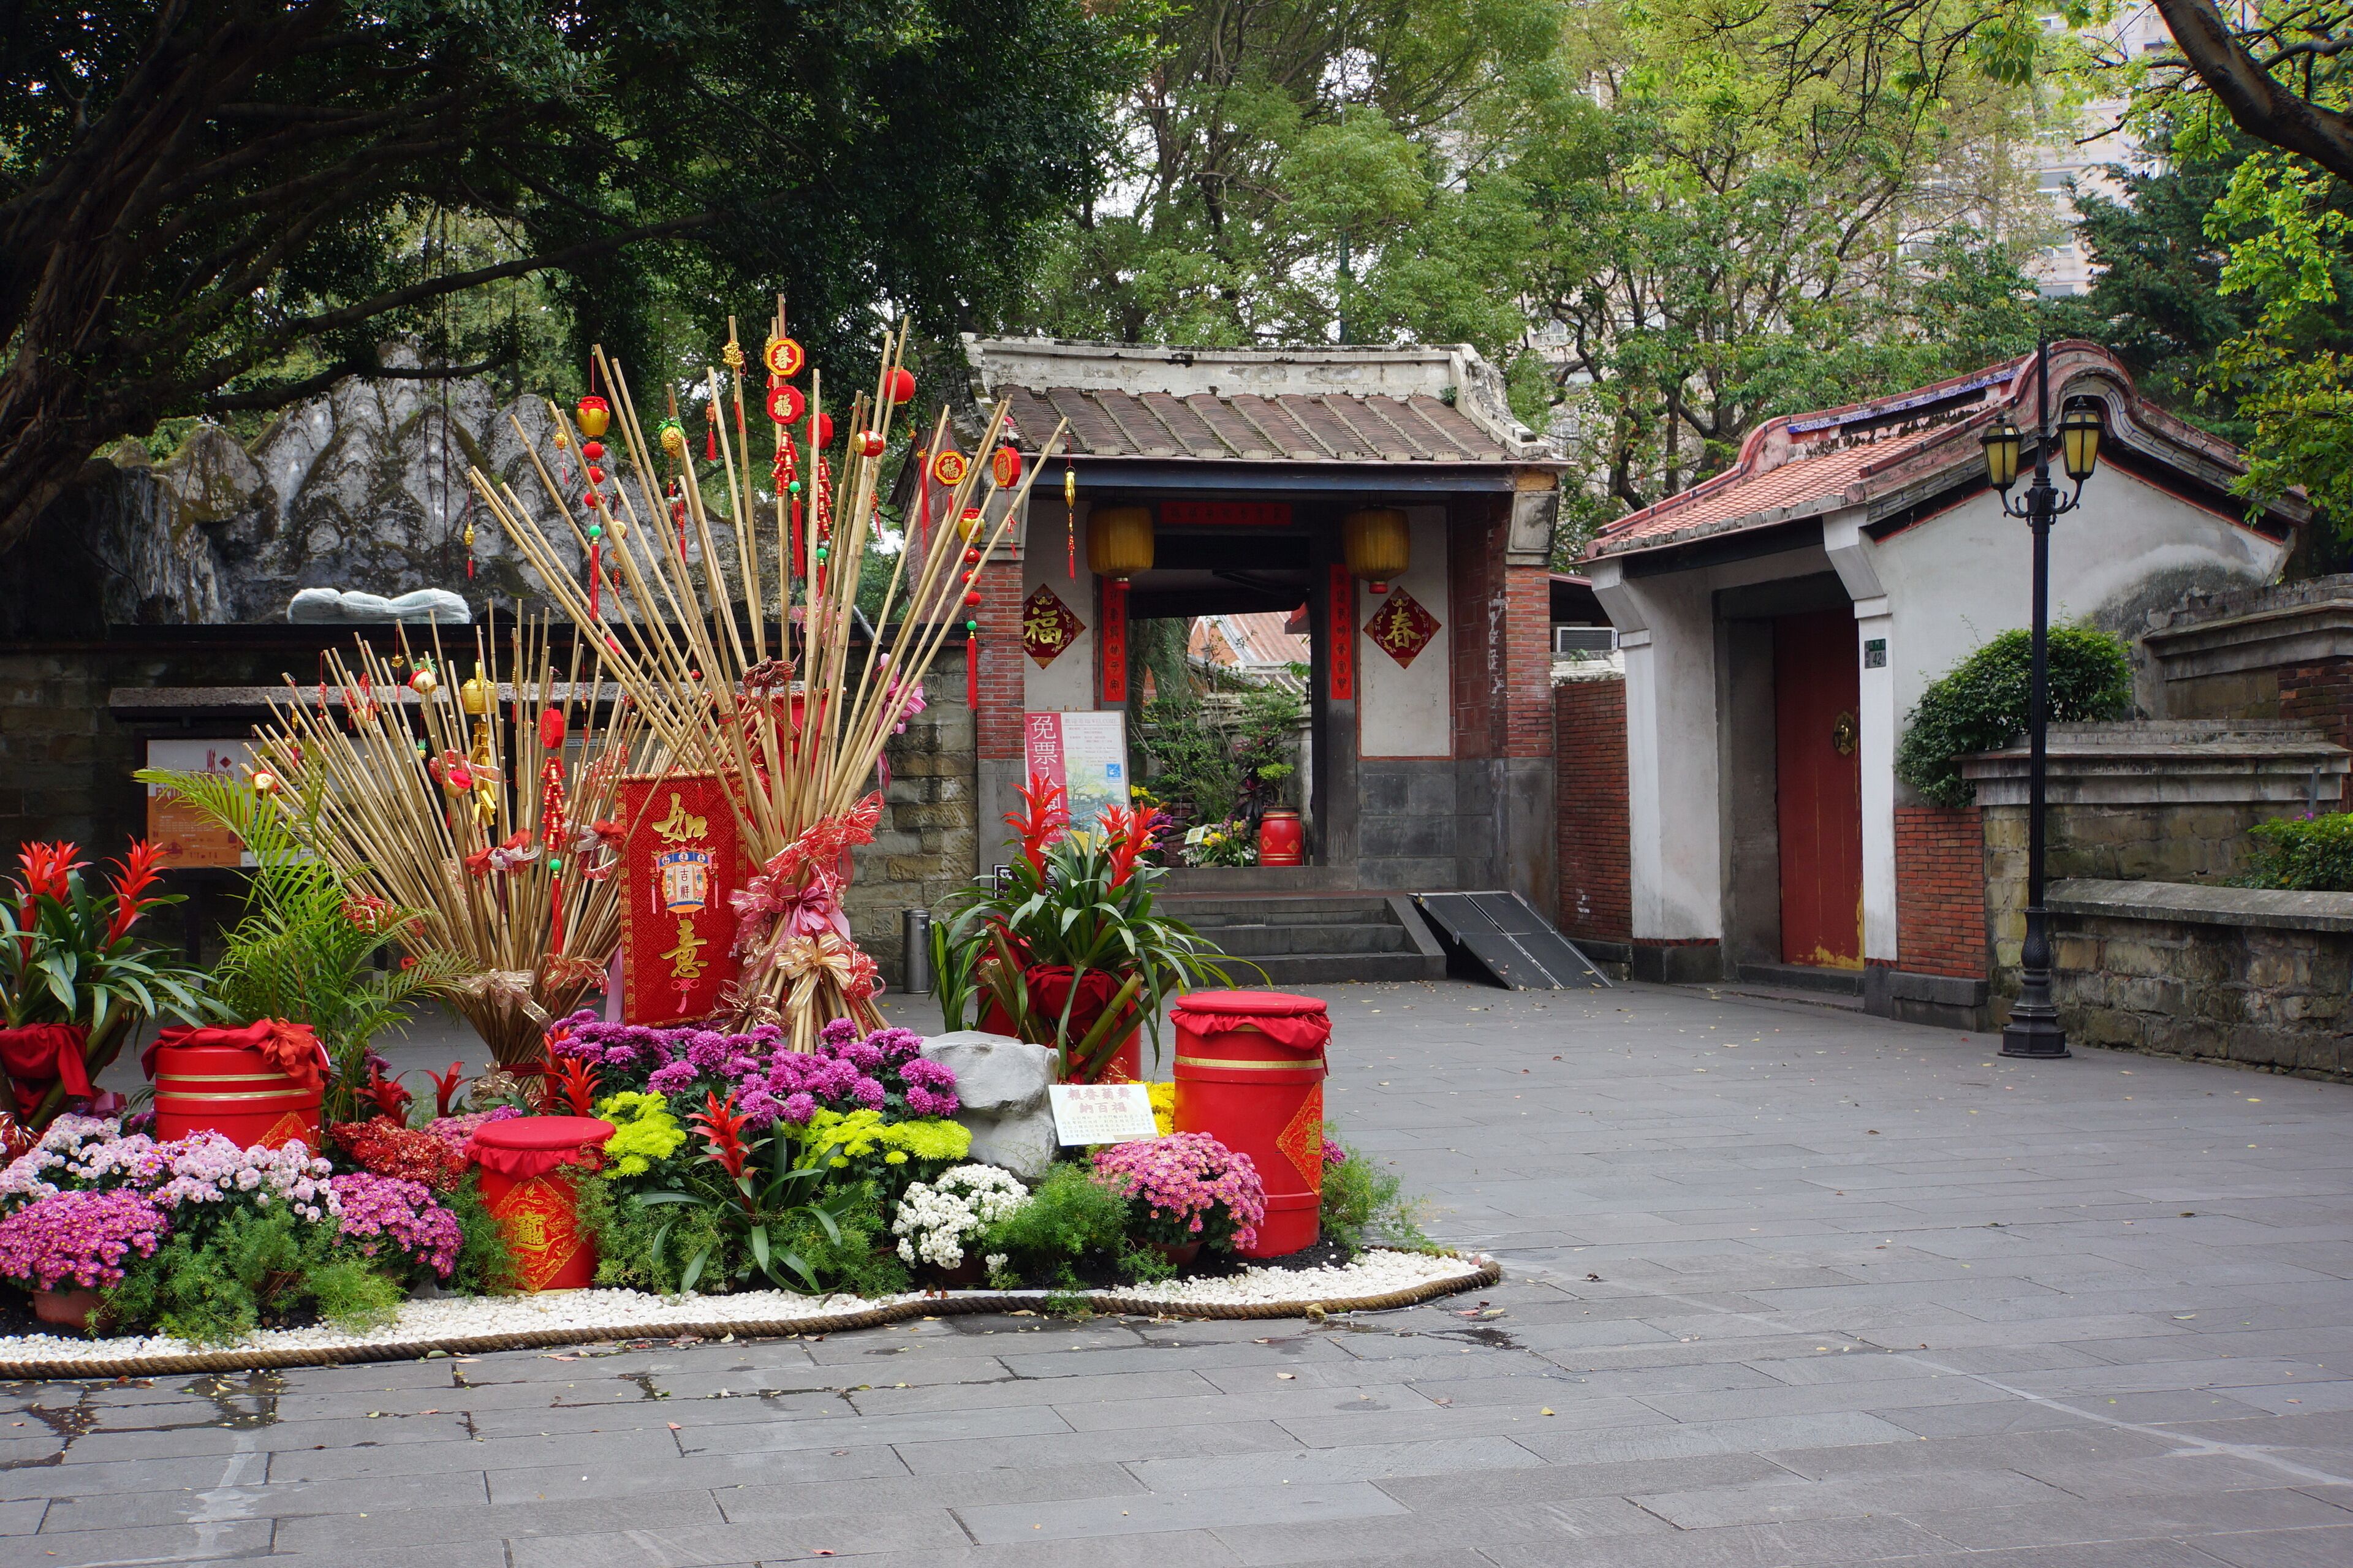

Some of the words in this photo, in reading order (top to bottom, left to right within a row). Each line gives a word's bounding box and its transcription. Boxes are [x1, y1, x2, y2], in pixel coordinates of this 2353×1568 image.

[775, 346, 794, 369] 春
[774, 393, 792, 417] 福
[942, 457, 960, 478] 福
[1023, 607, 1062, 645] 福
[1384, 607, 1422, 648] 春
[1873, 652, 1882, 665] 42
[680, 868, 690, 899] 吉祥
[1078, 1102, 1127, 1114] 納百福
